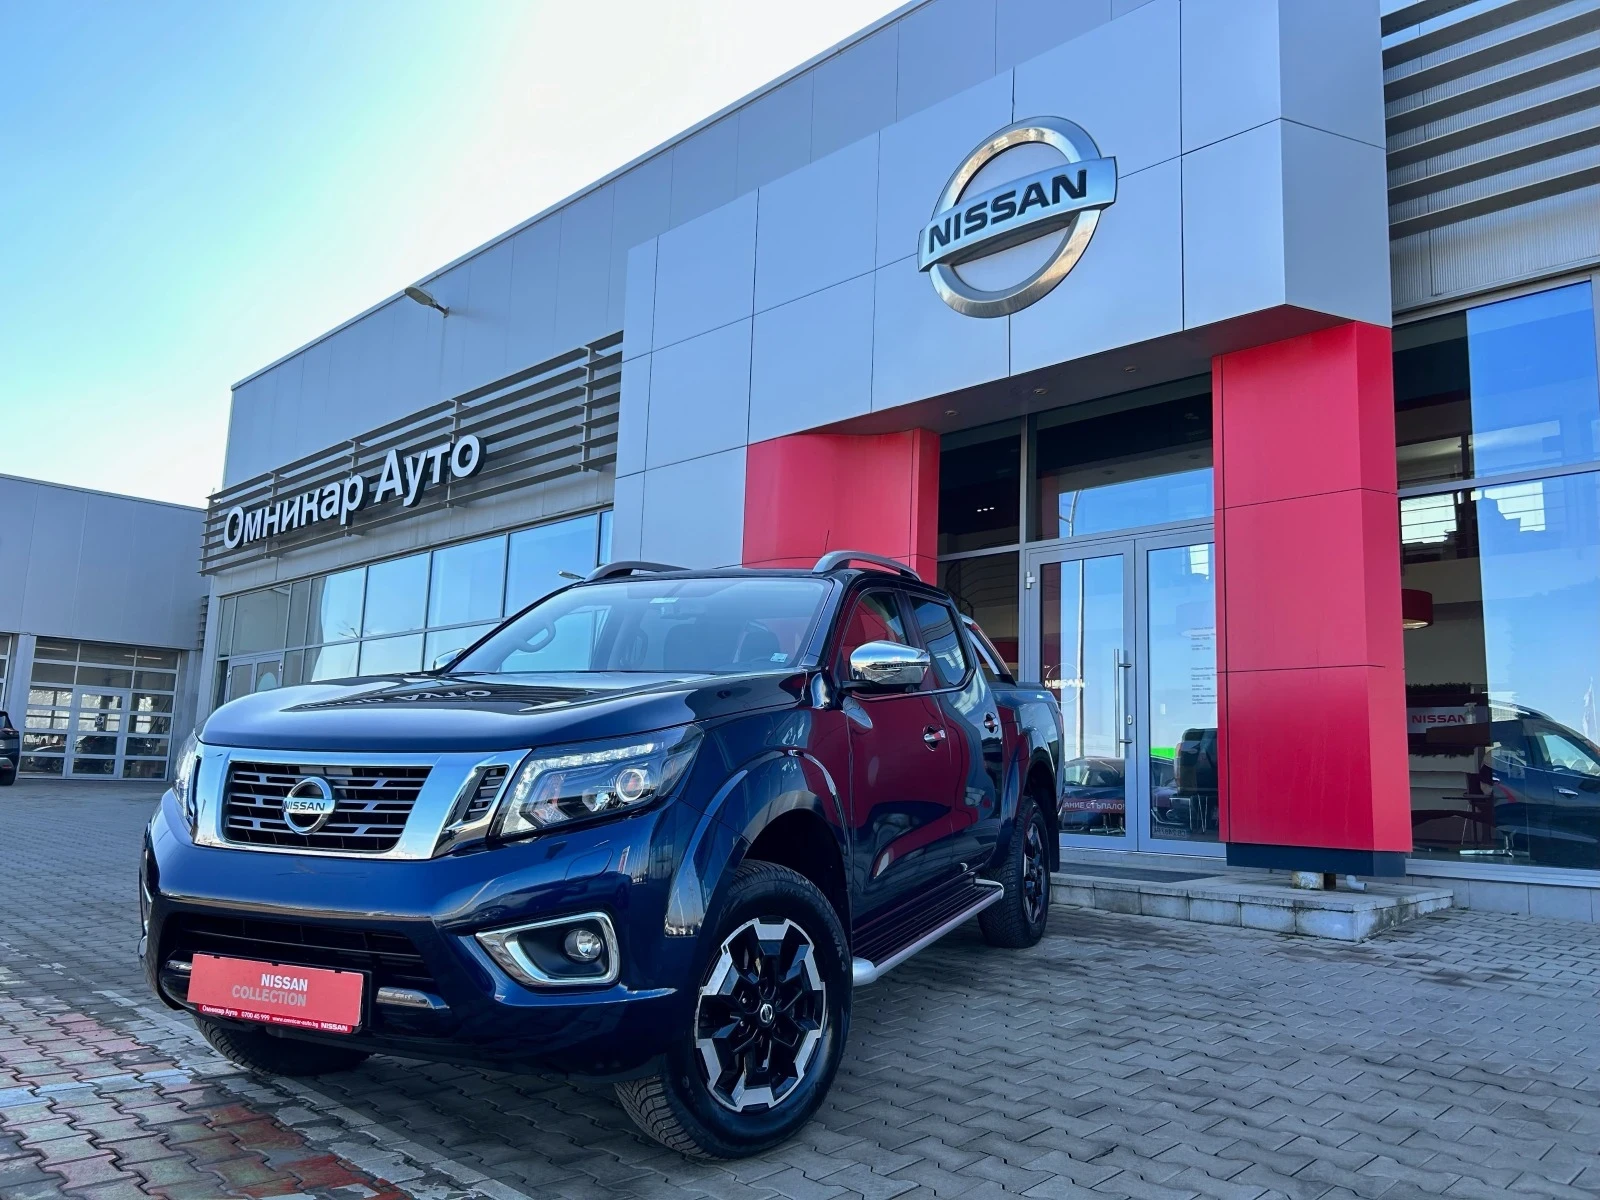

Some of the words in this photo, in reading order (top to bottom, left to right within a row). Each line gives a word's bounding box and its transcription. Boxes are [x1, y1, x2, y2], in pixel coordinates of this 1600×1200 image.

[928, 169, 1087, 254] NISSAN
[223, 474, 368, 549] Омникар
[374, 434, 485, 507] Ауто
[1411, 714, 1466, 724] NISSAN
[282, 799, 326, 811] NISSAN
[1063, 801, 1085, 809] АНИЕ
[261, 973, 308, 992] NISSAN
[232, 984, 307, 1007] COLLECTION
[225, 1008, 238, 1017] Ауто
[241, 1011, 253, 1019] 0700
[320, 1022, 348, 1032] NISSAN
